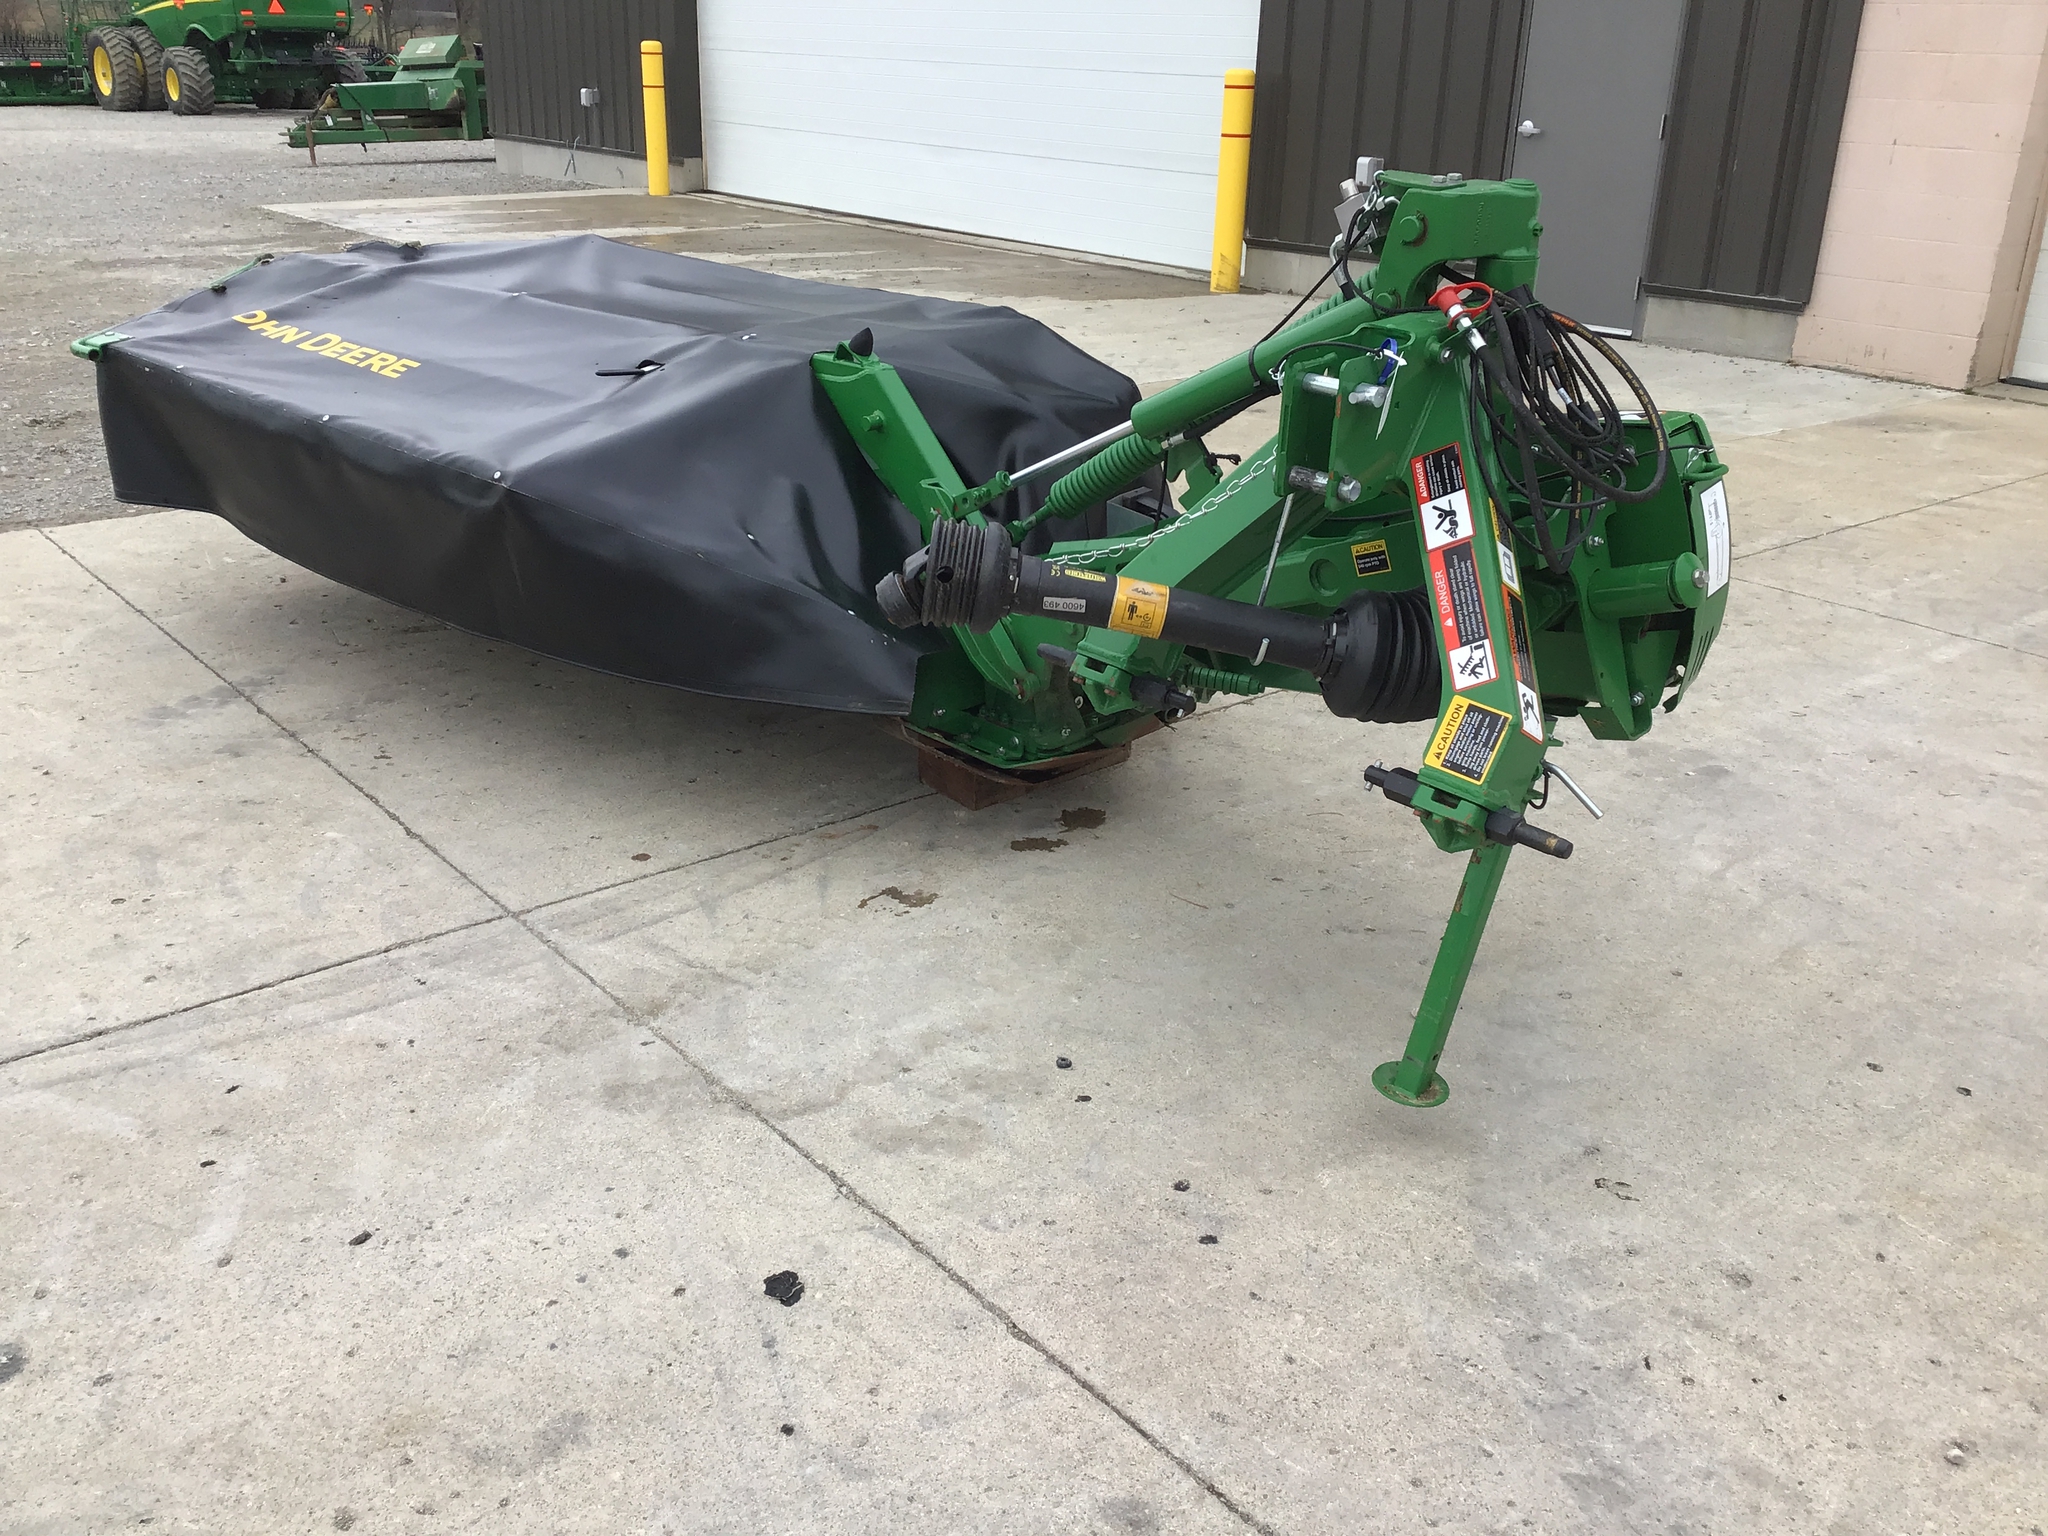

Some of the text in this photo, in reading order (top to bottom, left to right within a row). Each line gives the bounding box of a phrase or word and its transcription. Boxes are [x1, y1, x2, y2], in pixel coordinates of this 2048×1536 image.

[232, 310, 421, 378] OHN DEERE
[1416, 462, 1426, 493] DANGER
[1360, 544, 1383, 552] CAUTION
[1460, 561, 1469, 581] hydraulic
[1435, 570, 1450, 614] DANGER
[1464, 587, 1474, 612] Mechanical
[1062, 602, 1084, 610] 4600
[1464, 616, 1472, 635] machine
[1437, 704, 1464, 750] CAUTION
